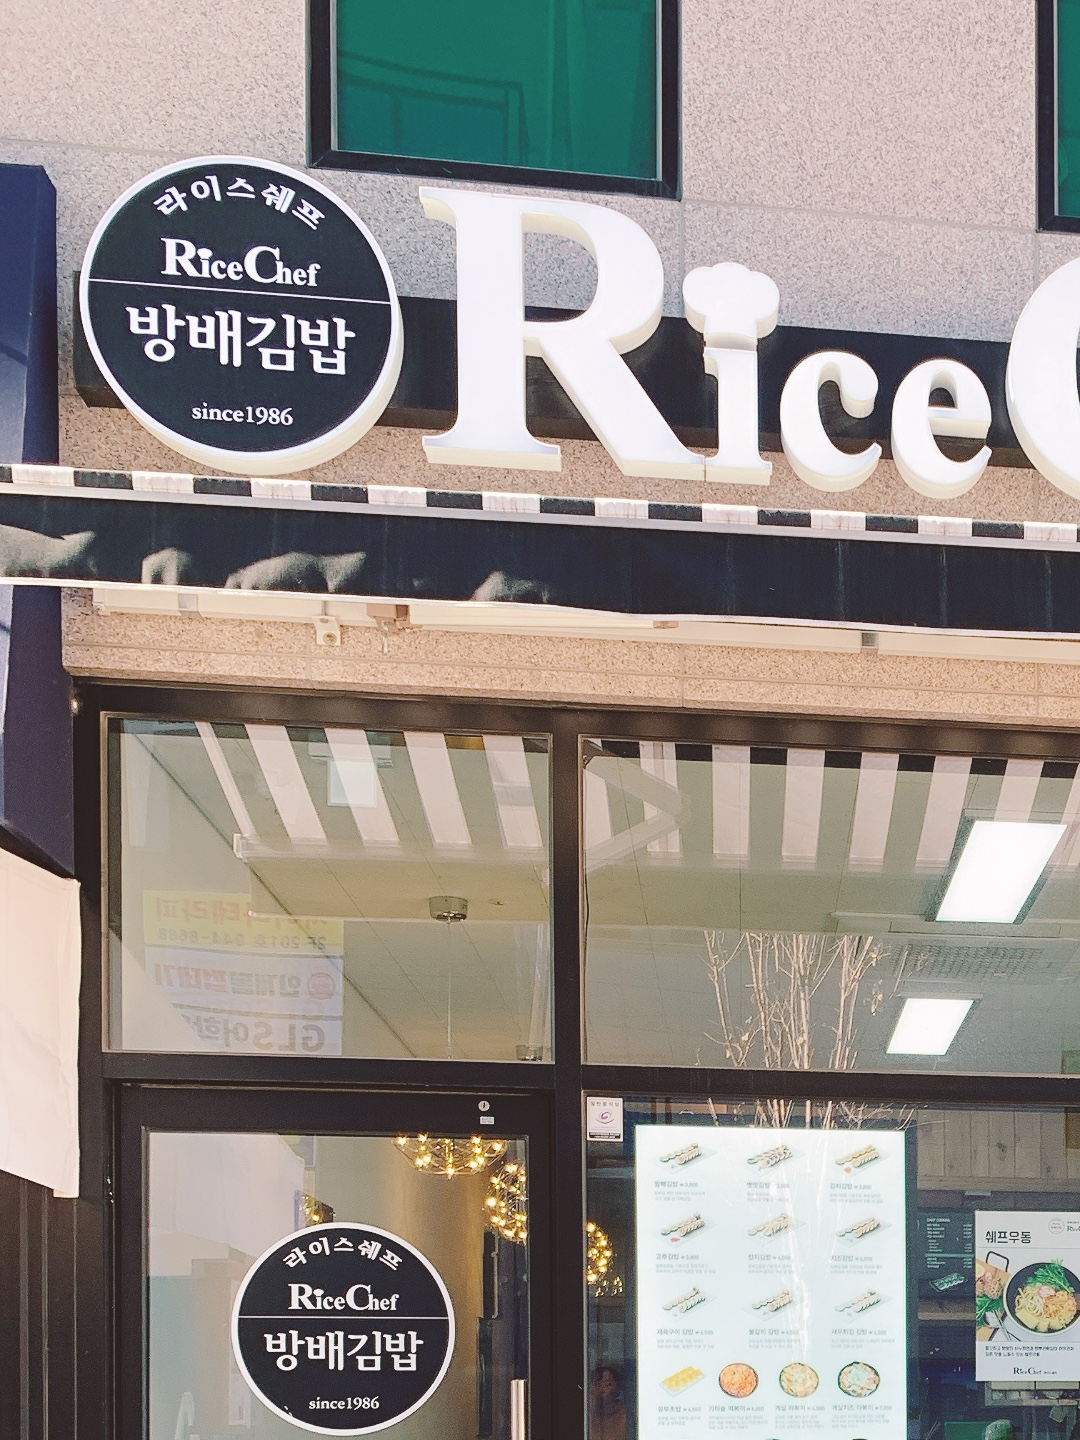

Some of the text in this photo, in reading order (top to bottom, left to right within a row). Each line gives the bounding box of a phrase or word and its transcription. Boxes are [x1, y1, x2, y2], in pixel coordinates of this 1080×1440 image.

[153, 175, 325, 230] 라이스쉐프
[160, 237, 321, 287] RiceChef
[126, 304, 356, 375] 방배김밥
[191, 402, 294, 426] since1986
[283, 1236, 403, 1271] 라이스쉐프
[985, 1230, 1031, 1243] 쉐프우동
[288, 1283, 399, 1311] RiceChef
[264, 1330, 423, 1371] 방배김밥
[308, 1396, 380, 1411] since1986
